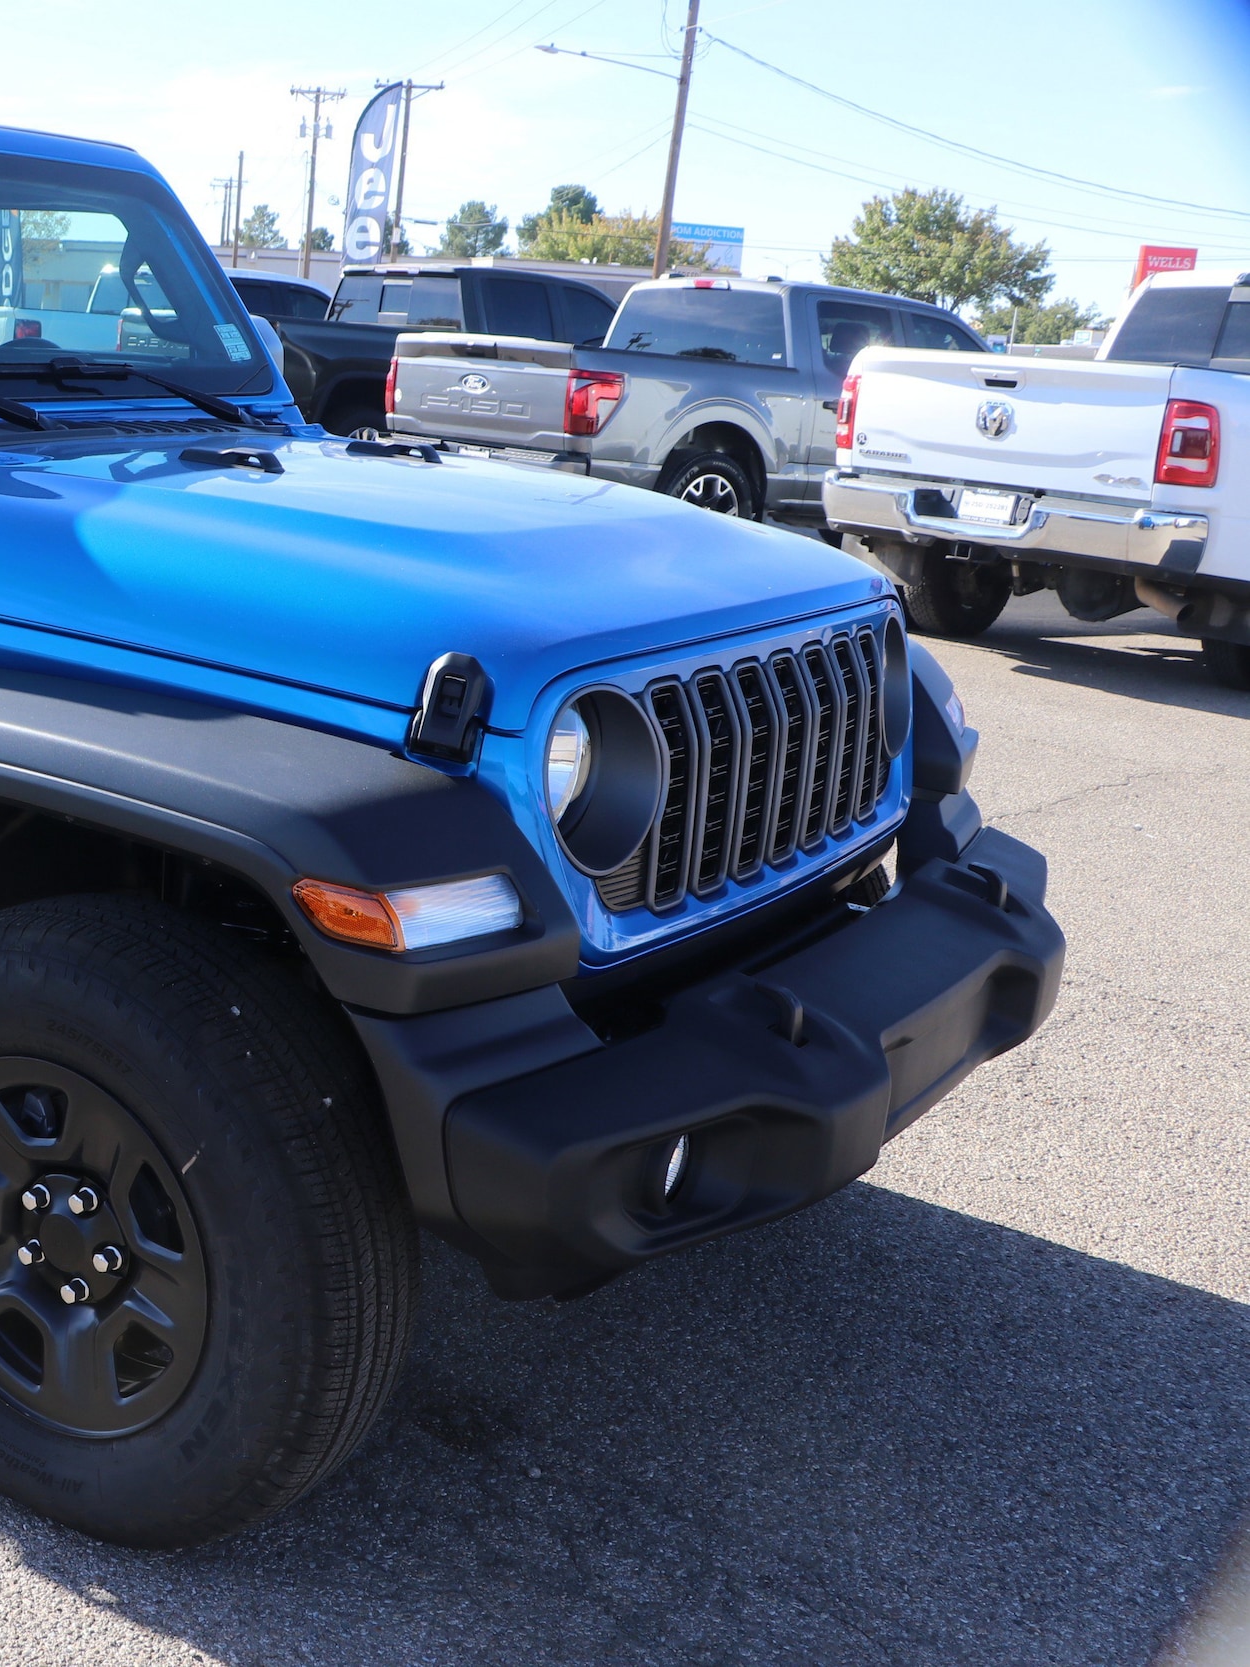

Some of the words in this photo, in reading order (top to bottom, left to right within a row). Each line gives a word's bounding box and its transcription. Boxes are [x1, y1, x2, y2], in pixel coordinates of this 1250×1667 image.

[346, 104, 396, 260] Jee
[694, 228, 743, 239] ADDICTION
[1148, 255, 1192, 269] WELLS
[463, 374, 488, 392] Ford
[420, 393, 531, 419] F-150
